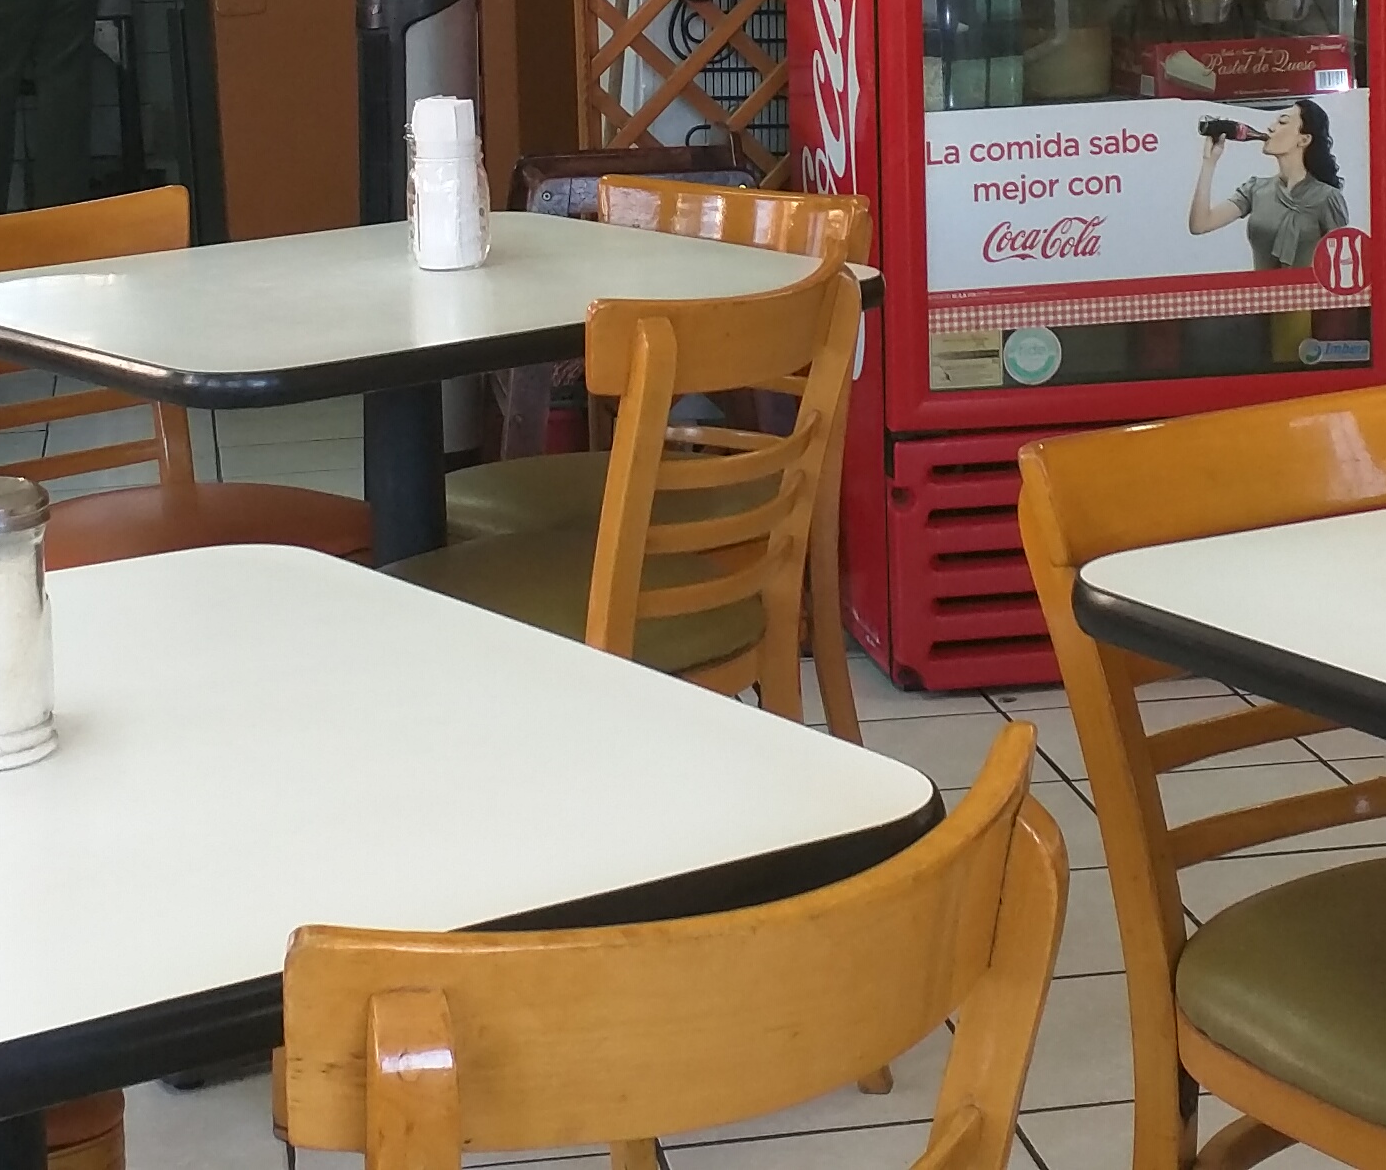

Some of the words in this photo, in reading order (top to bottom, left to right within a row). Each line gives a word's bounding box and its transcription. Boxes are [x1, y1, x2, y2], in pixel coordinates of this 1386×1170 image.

[1201, 52, 1253, 77] Pastel
[1252, 54, 1270, 74] de
[1269, 49, 1316, 73] Queso
[926, 140, 960, 166] La
[969, 132, 1080, 163] comida
[1089, 128, 1159, 155] sabe
[973, 176, 1060, 204] mejor
[1068, 174, 1122, 196] con
[982, 215, 1108, 264] Coca-Cola
